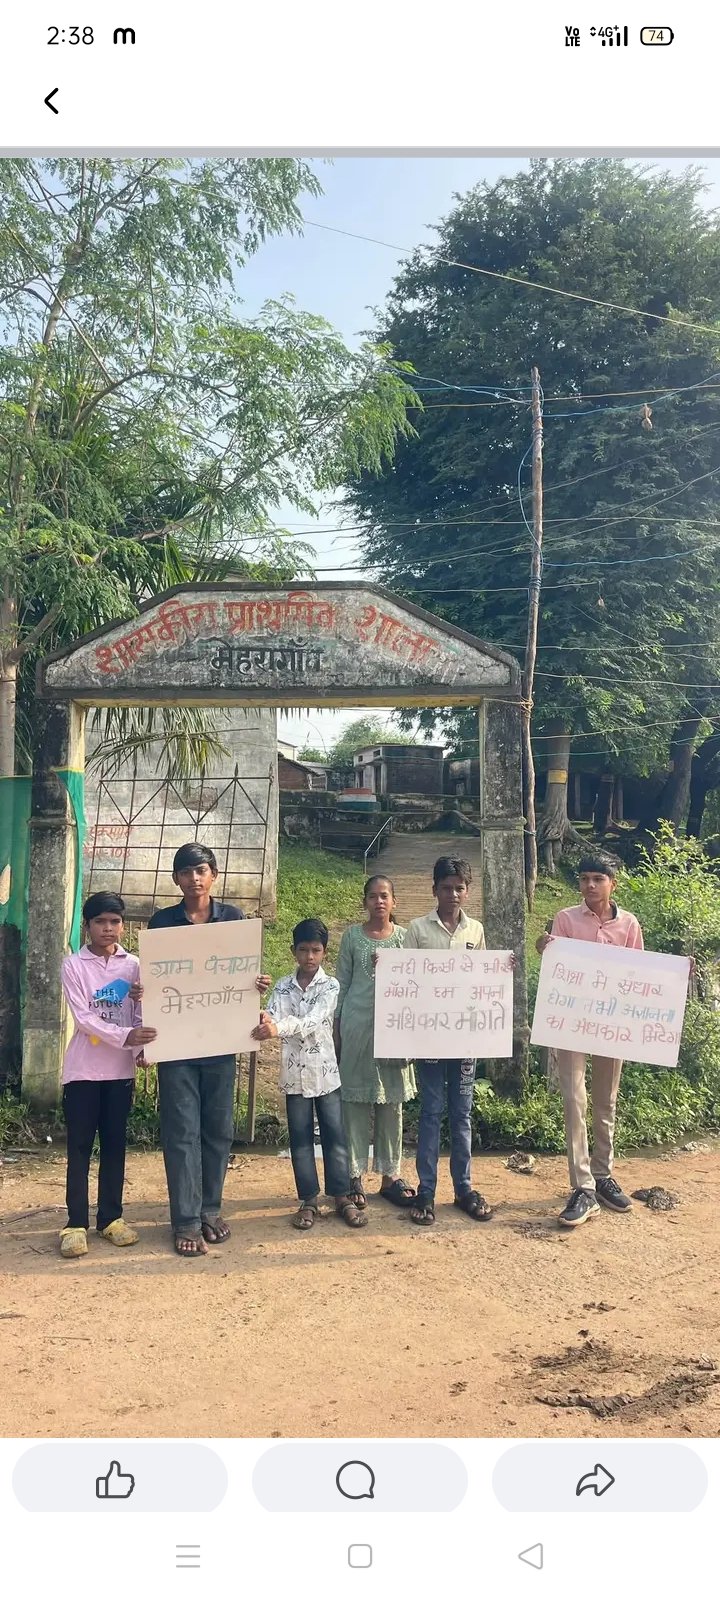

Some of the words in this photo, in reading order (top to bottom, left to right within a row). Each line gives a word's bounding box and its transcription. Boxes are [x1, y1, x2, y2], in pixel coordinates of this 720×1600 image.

[355, 604, 441, 668] शाला
[210, 638, 325, 676] मेहरागाँव
[149, 959, 193, 979] ग्राम
[204, 954, 259, 975] पंचायत
[423, 957, 455, 975] किसी
[460, 954, 474, 973] से
[551, 962, 586, 986] शिक्षा
[95, 988, 115, 997] THE
[160, 986, 252, 1015] मेहरागाँव
[384, 979, 423, 999] माँगते
[470, 984, 505, 1001] अपना
[88, 999, 123, 1009] FUTURE
[546, 988, 576, 1009] होगा
[583, 996, 618, 1017] तभी
[101, 1011, 114, 1019] OF
[385, 1006, 450, 1032] अधिकार
[455, 1001, 506, 1032] माँगते
[546, 1014, 565, 1031] का
